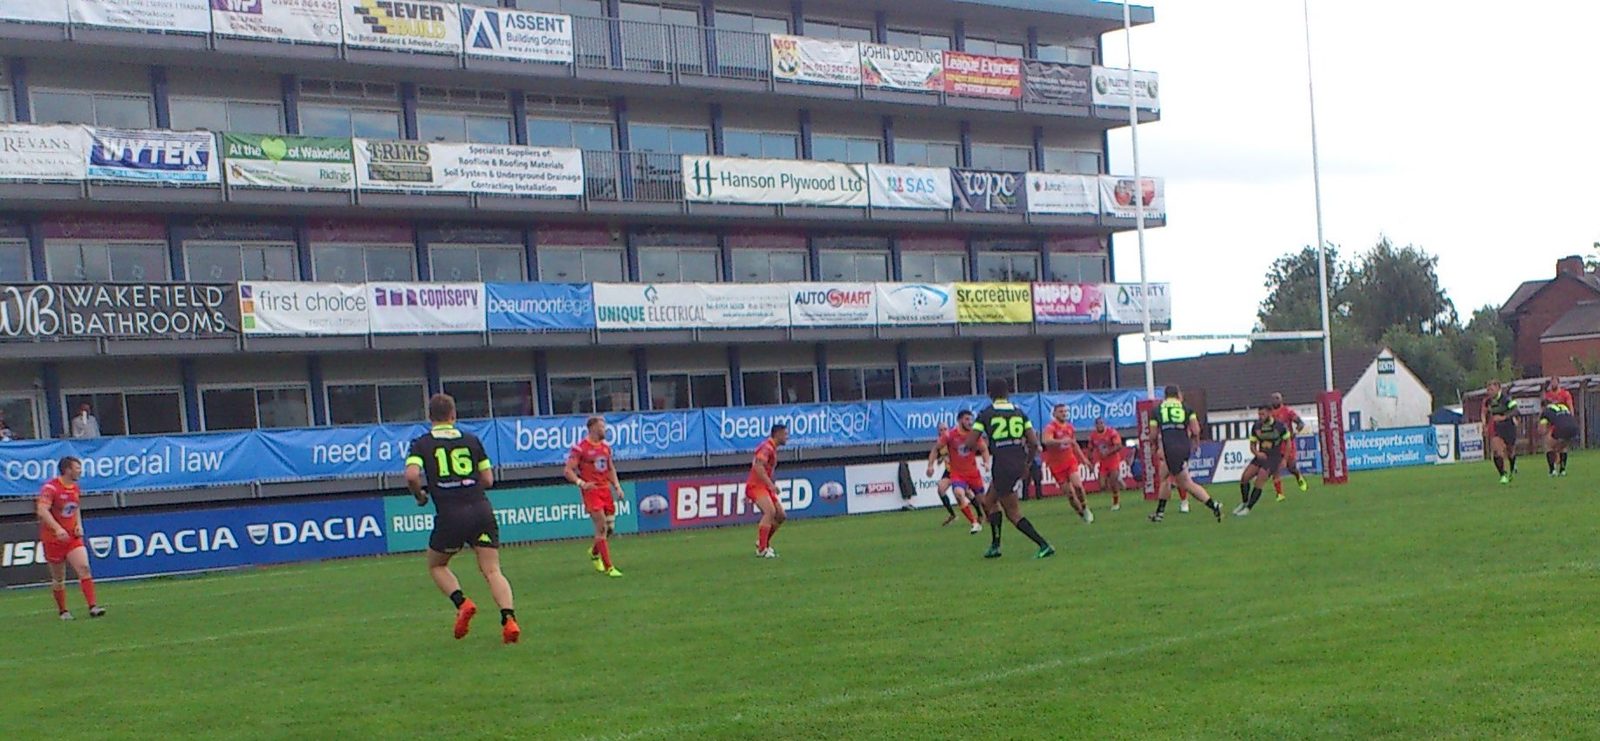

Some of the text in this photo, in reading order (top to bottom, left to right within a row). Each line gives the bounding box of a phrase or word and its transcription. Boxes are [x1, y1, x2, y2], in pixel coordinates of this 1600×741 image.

[393, 2, 445, 21] EVER
[505, 13, 565, 33] ASSENT
[506, 32, 540, 46] Building
[861, 45, 942, 65] JOHN DUDDING
[944, 53, 980, 74] League
[981, 59, 1020, 77] Express
[101, 138, 203, 165] WYTEK
[229, 144, 350, 160] At the of Wakefield
[366, 142, 430, 162] TRIMS
[469, 146, 505, 155] Specialist
[506, 148, 541, 158] Suppliers
[458, 157, 565, 170] Roofline & Roofing Materials
[320, 167, 352, 183] Ridings
[443, 168, 459, 177] Soil
[460, 168, 488, 178] System
[496, 171, 546, 181] Underground
[547, 173, 582, 183] Drainage
[720, 171, 863, 195] Hanson Plywood Ltd
[471, 180, 558, 192] Contracting Installation
[905, 177, 936, 194] SAS
[66, 286, 223, 307] WAKEFIELD
[259, 290, 367, 312] first choice
[419, 285, 479, 309] copiserv
[956, 286, 1030, 303] sr.creative
[1129, 285, 1166, 298] TRITY
[70, 312, 226, 334] BATHROOMS
[598, 305, 707, 322] UNIQUE ELECTRICAL
[906, 406, 960, 431] movin
[1050, 401, 1101, 424] spute
[1160, 407, 1185, 423] 19
[990, 416, 1024, 439] 26
[180, 446, 224, 473] law
[312, 435, 372, 464] need
[378, 441, 391, 460] a
[1223, 451, 1244, 465] £30
[1362, 453, 1386, 466] Travel
[1387, 450, 1420, 466] Specialist
[434, 447, 473, 477] 16
[676, 477, 814, 520] BETED
[116, 515, 383, 560] DACIA DACIA
